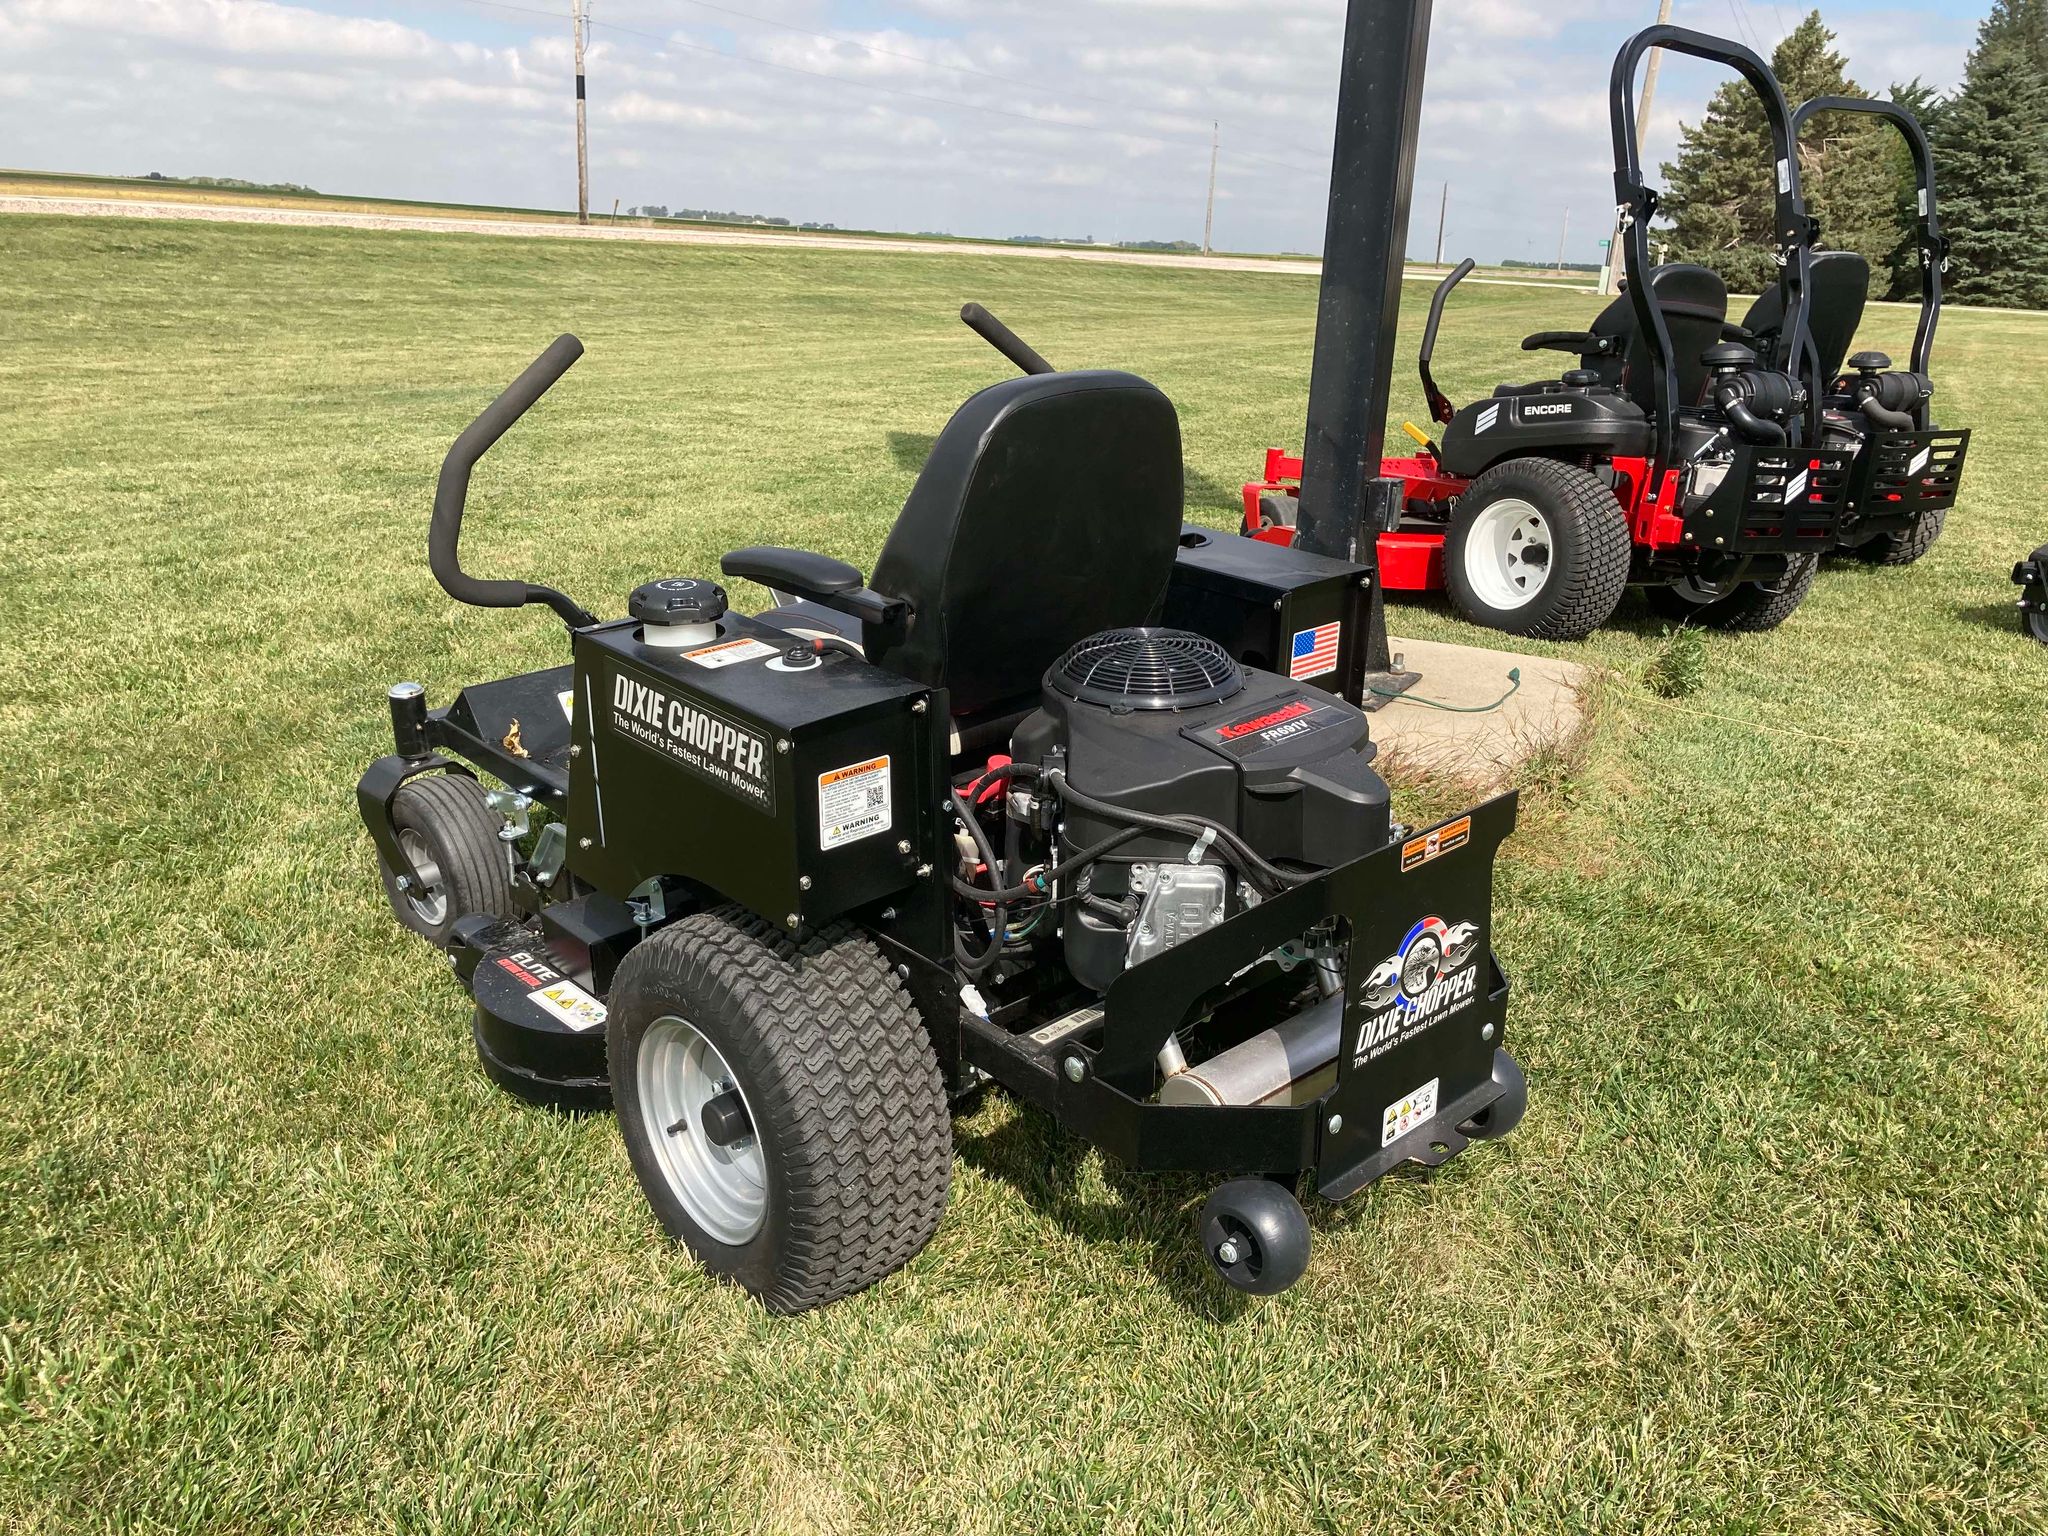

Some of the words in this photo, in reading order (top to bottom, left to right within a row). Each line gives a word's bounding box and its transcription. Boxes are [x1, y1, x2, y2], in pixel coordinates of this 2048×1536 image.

[1524, 403, 1573, 416] ENCORE
[613, 673, 665, 729] DIXIE
[667, 700, 764, 779] CHOPPER
[1215, 701, 1313, 739] Kawasaki
[1260, 719, 1309, 741] FR691V
[613, 711, 629, 730] The
[631, 720, 665, 748] World's
[667, 738, 701, 767] Fastest
[703, 756, 729, 781] Lawn
[841, 763, 876, 779] WARNING
[842, 814, 880, 831] WARNING
[1165, 912, 1177, 951] V-VALV
[509, 952, 560, 982] ELITE
[1356, 1004, 1404, 1055] DIXIE
[1403, 965, 1477, 1027] CHOPPER
[1354, 1054, 1369, 1068] The
[1370, 1036, 1399, 1060] World's
[1400, 1020, 1428, 1043] Fastest
[1428, 1010, 1448, 1027] Lawn
